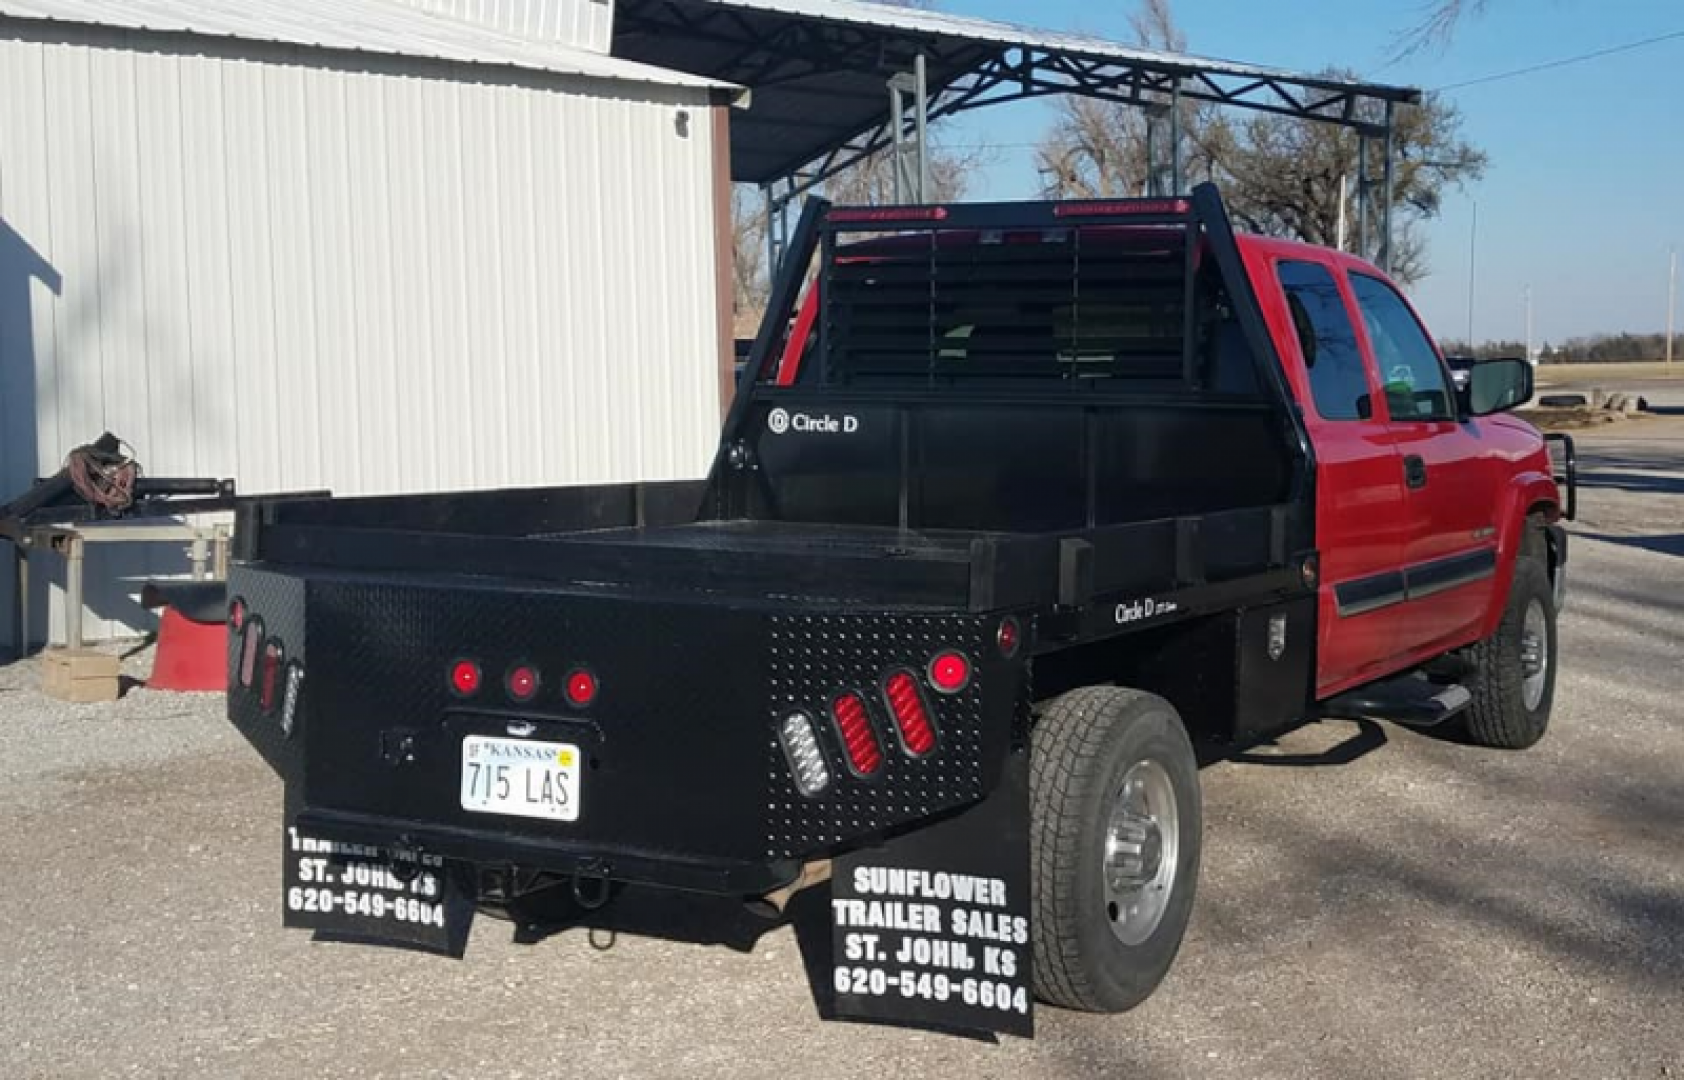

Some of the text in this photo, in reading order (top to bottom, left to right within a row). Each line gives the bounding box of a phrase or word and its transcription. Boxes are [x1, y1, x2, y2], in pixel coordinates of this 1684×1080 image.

[791, 412, 839, 433] Circle
[843, 414, 858, 433] D
[489, 743, 554, 760] KANSAS
[468, 762, 570, 805] 715 LAS
[299, 857, 334, 883] ST.
[853, 866, 1007, 907] SUNFLOWER
[287, 886, 445, 928] 620-549-6604
[831, 898, 1029, 944] TRAILER SALES
[845, 932, 888, 961] ST.
[982, 945, 1017, 977] KS
[833, 966, 1029, 1015] 620-549-6604
